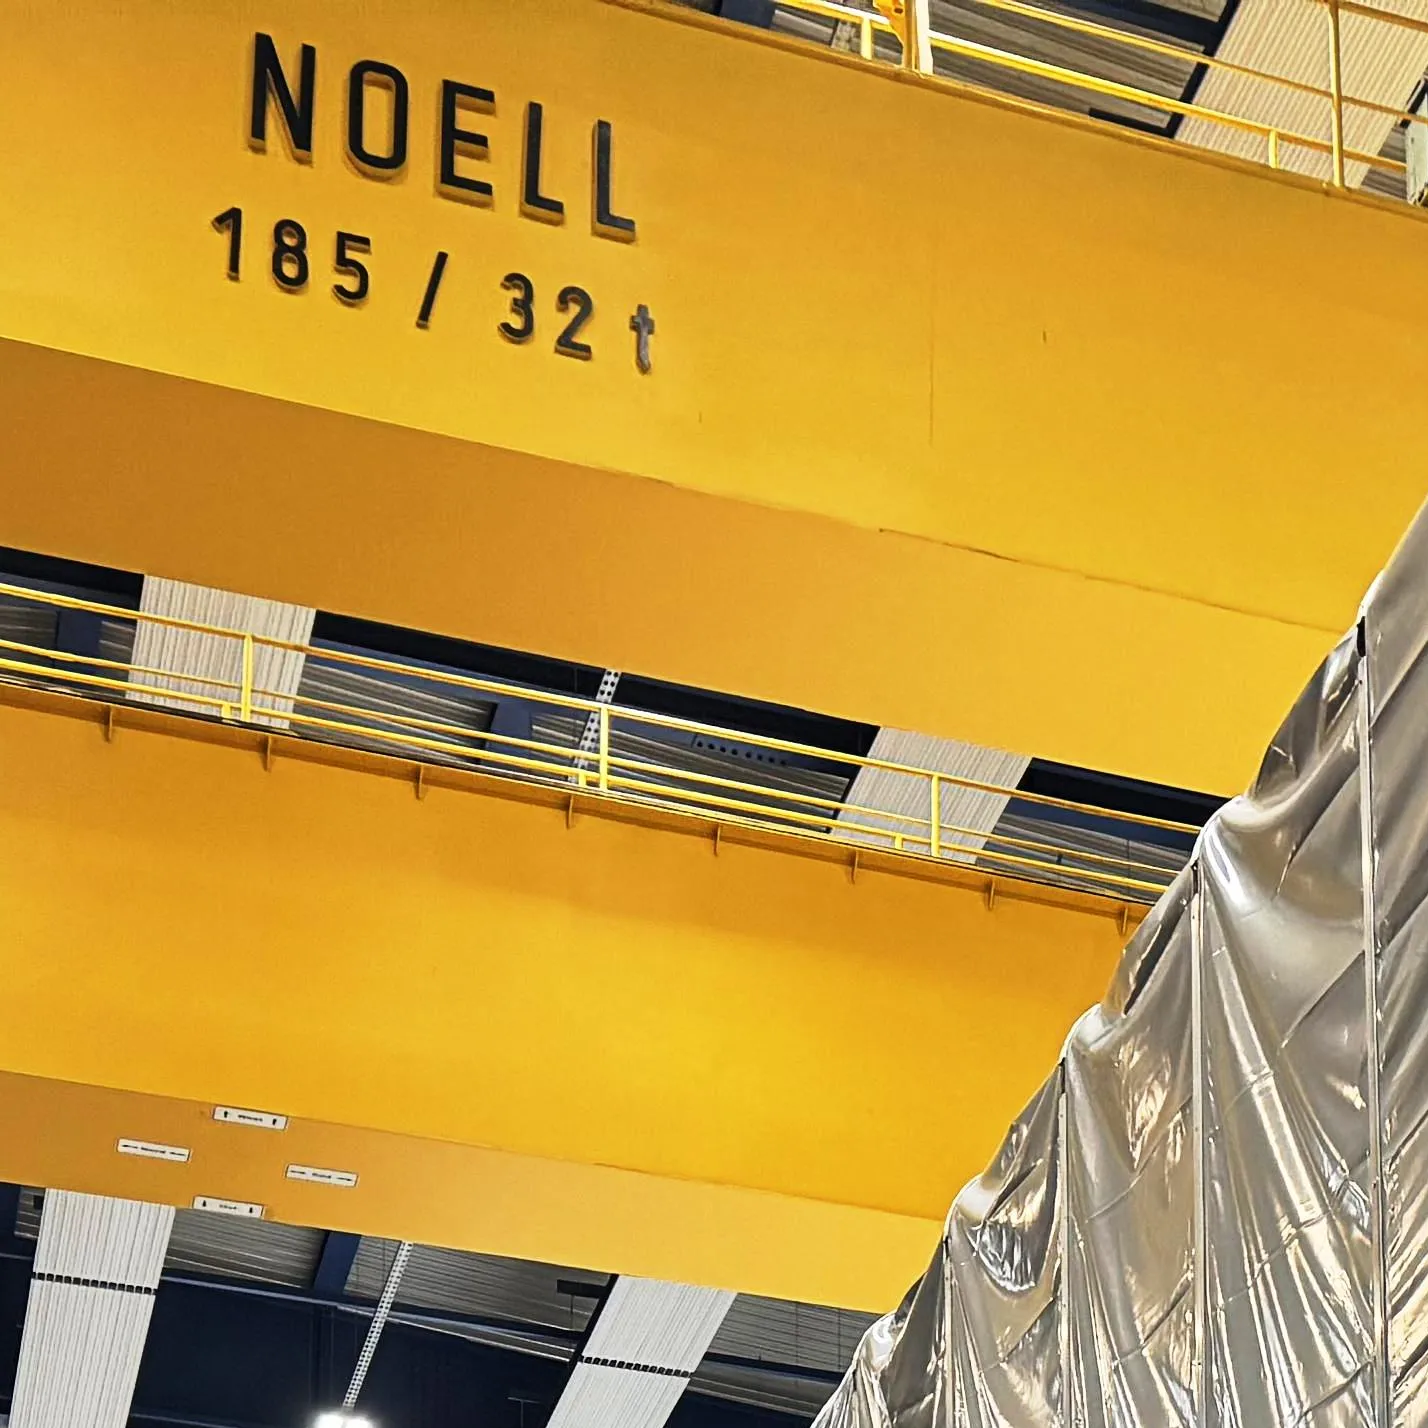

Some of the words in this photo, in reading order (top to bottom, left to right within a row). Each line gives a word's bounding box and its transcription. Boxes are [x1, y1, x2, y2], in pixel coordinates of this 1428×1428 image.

[249, 32, 636, 236] NOELL
[212, 207, 371, 304] 185
[417, 251, 450, 328] /
